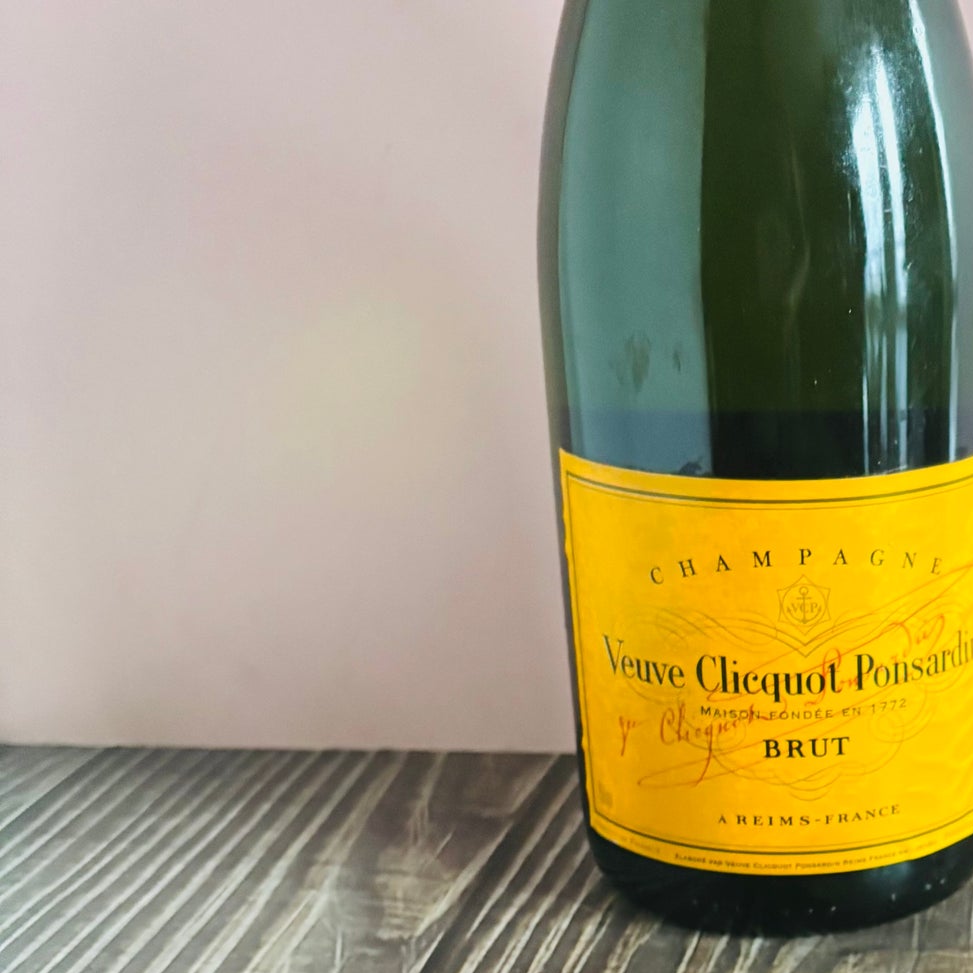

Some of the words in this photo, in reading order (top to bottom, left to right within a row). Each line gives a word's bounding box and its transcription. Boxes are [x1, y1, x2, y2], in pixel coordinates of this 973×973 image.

[650, 548, 943, 586] CHAMPAGNE
[603, 633, 686, 689] Veuve
[695, 653, 842, 703] Clicquot
[700, 705, 761, 720] MAISON
[768, 708, 834, 721] FONDÉE
[841, 706, 862, 718] EN
[871, 698, 908, 715] 1772
[762, 736, 850, 759] BRUT
[735, 804, 901, 827] REIMS-FRANCE
